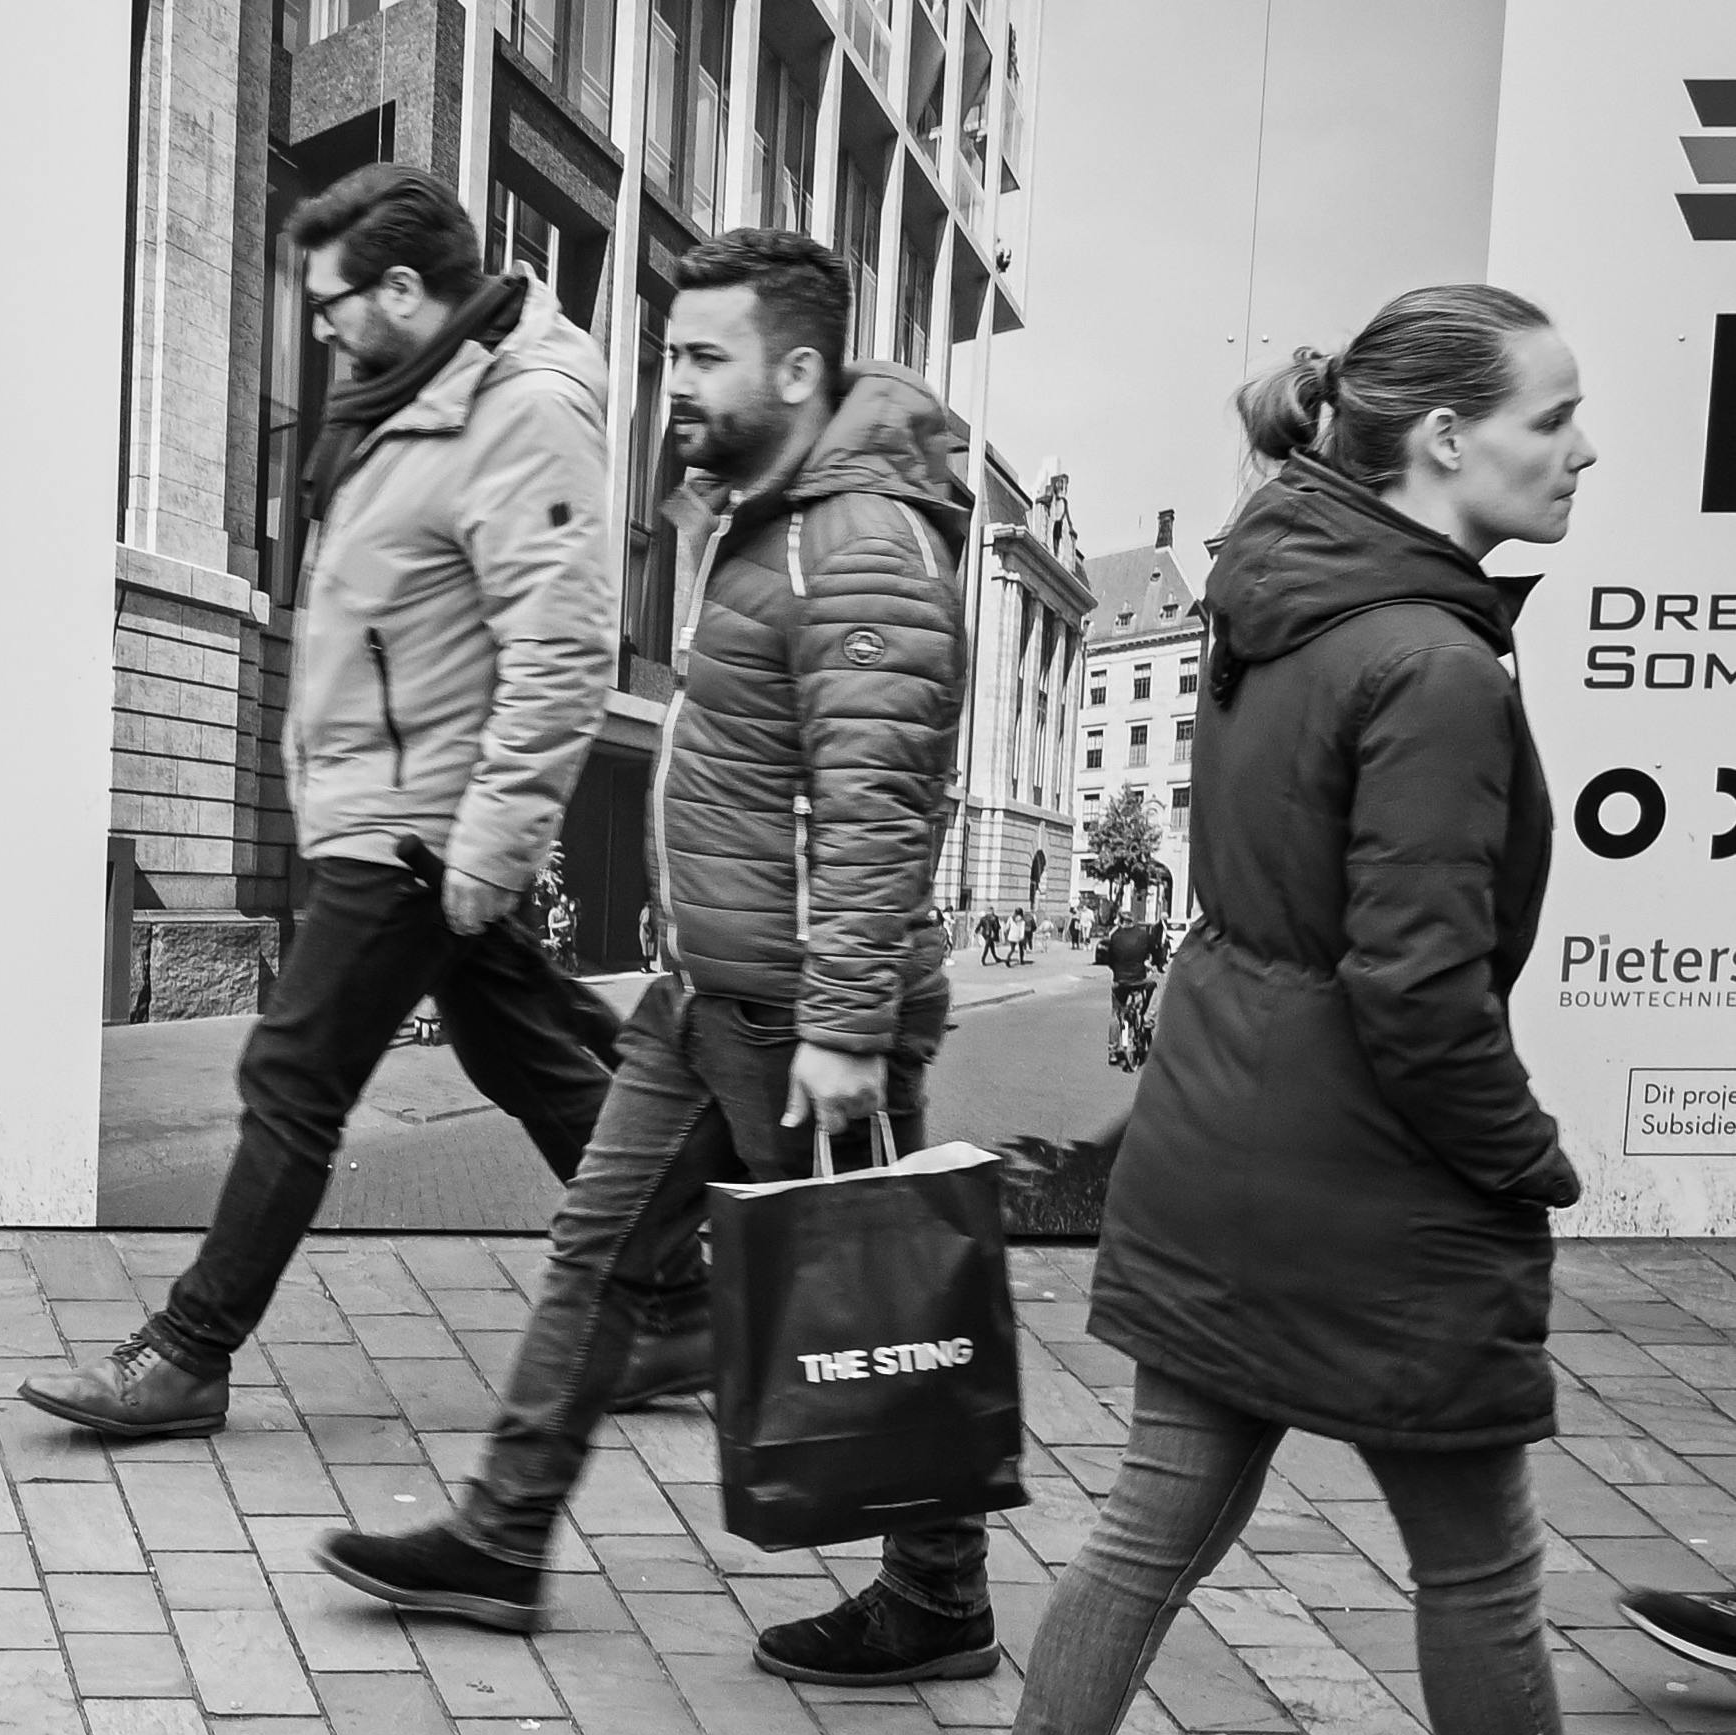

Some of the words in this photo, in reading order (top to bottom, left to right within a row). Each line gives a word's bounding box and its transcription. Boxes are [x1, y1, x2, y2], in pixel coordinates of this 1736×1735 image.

[1644, 1083, 1675, 1104] Dit
[1642, 1112, 1736, 1135] Subsidie
[797, 1349, 871, 1384] THE
[872, 1337, 975, 1377] STING
